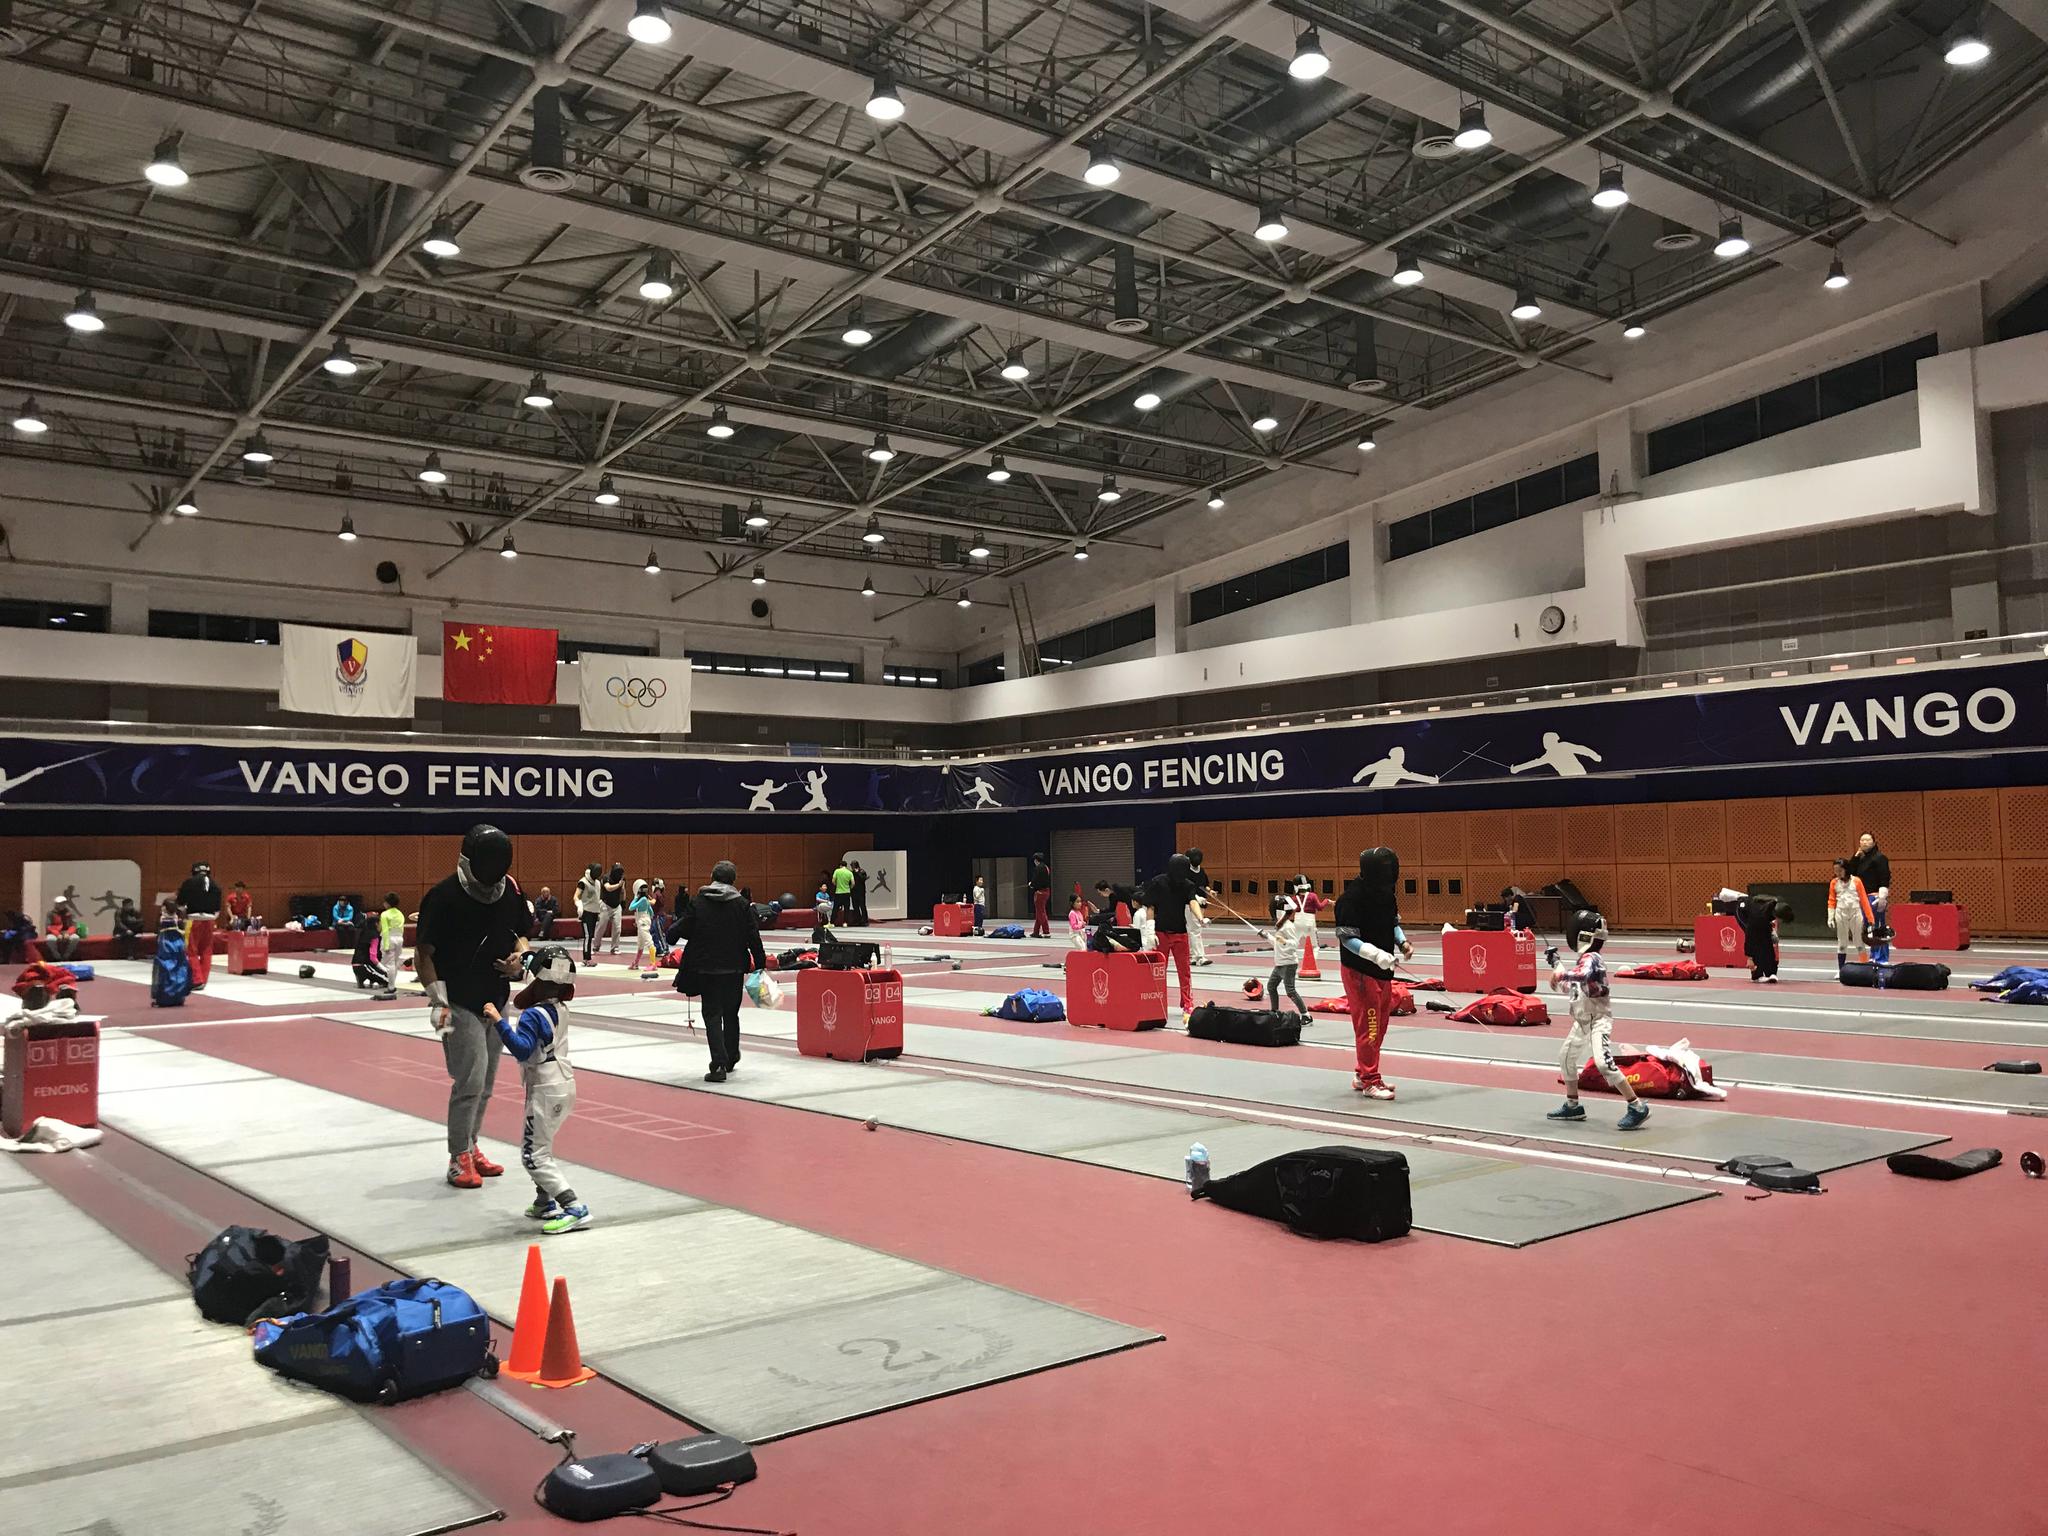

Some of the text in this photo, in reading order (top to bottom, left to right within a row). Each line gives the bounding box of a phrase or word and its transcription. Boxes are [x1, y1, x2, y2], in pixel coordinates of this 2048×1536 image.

[1779, 687, 2016, 746] VANGO
[238, 760, 614, 798] VANGO FENCING
[1038, 749, 1285, 796] VANGO FENCING
[1153, 966, 1166, 977] 05
[865, 987, 900, 1001] 03 04
[871, 1015, 897, 1025] VANGO
[31, 1043, 96, 1062] 01 02
[33, 1083, 89, 1097] FENCING
[837, 1337, 942, 1371] 2
